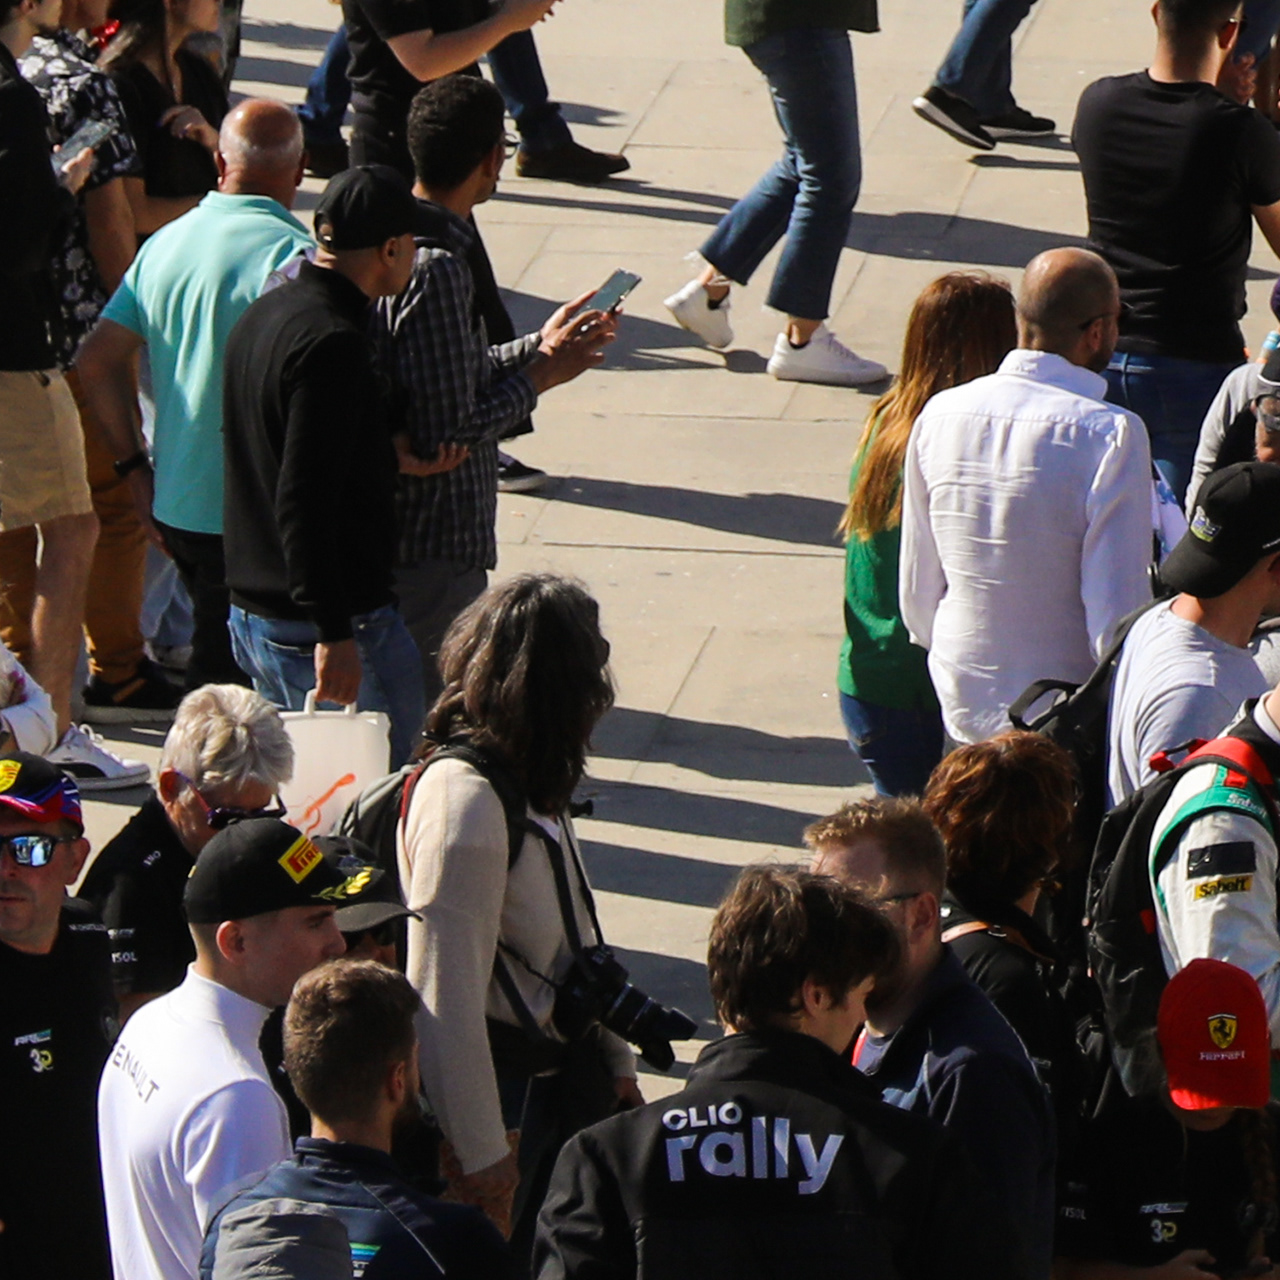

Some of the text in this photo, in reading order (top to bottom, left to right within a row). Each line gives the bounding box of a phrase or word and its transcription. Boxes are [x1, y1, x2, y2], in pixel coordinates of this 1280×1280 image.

[1199, 875, 1248, 898] Sabelt
[113, 1043, 160, 1104] ENAULT
[662, 1101, 743, 1132] CLIO
[665, 1116, 845, 1195] rally
